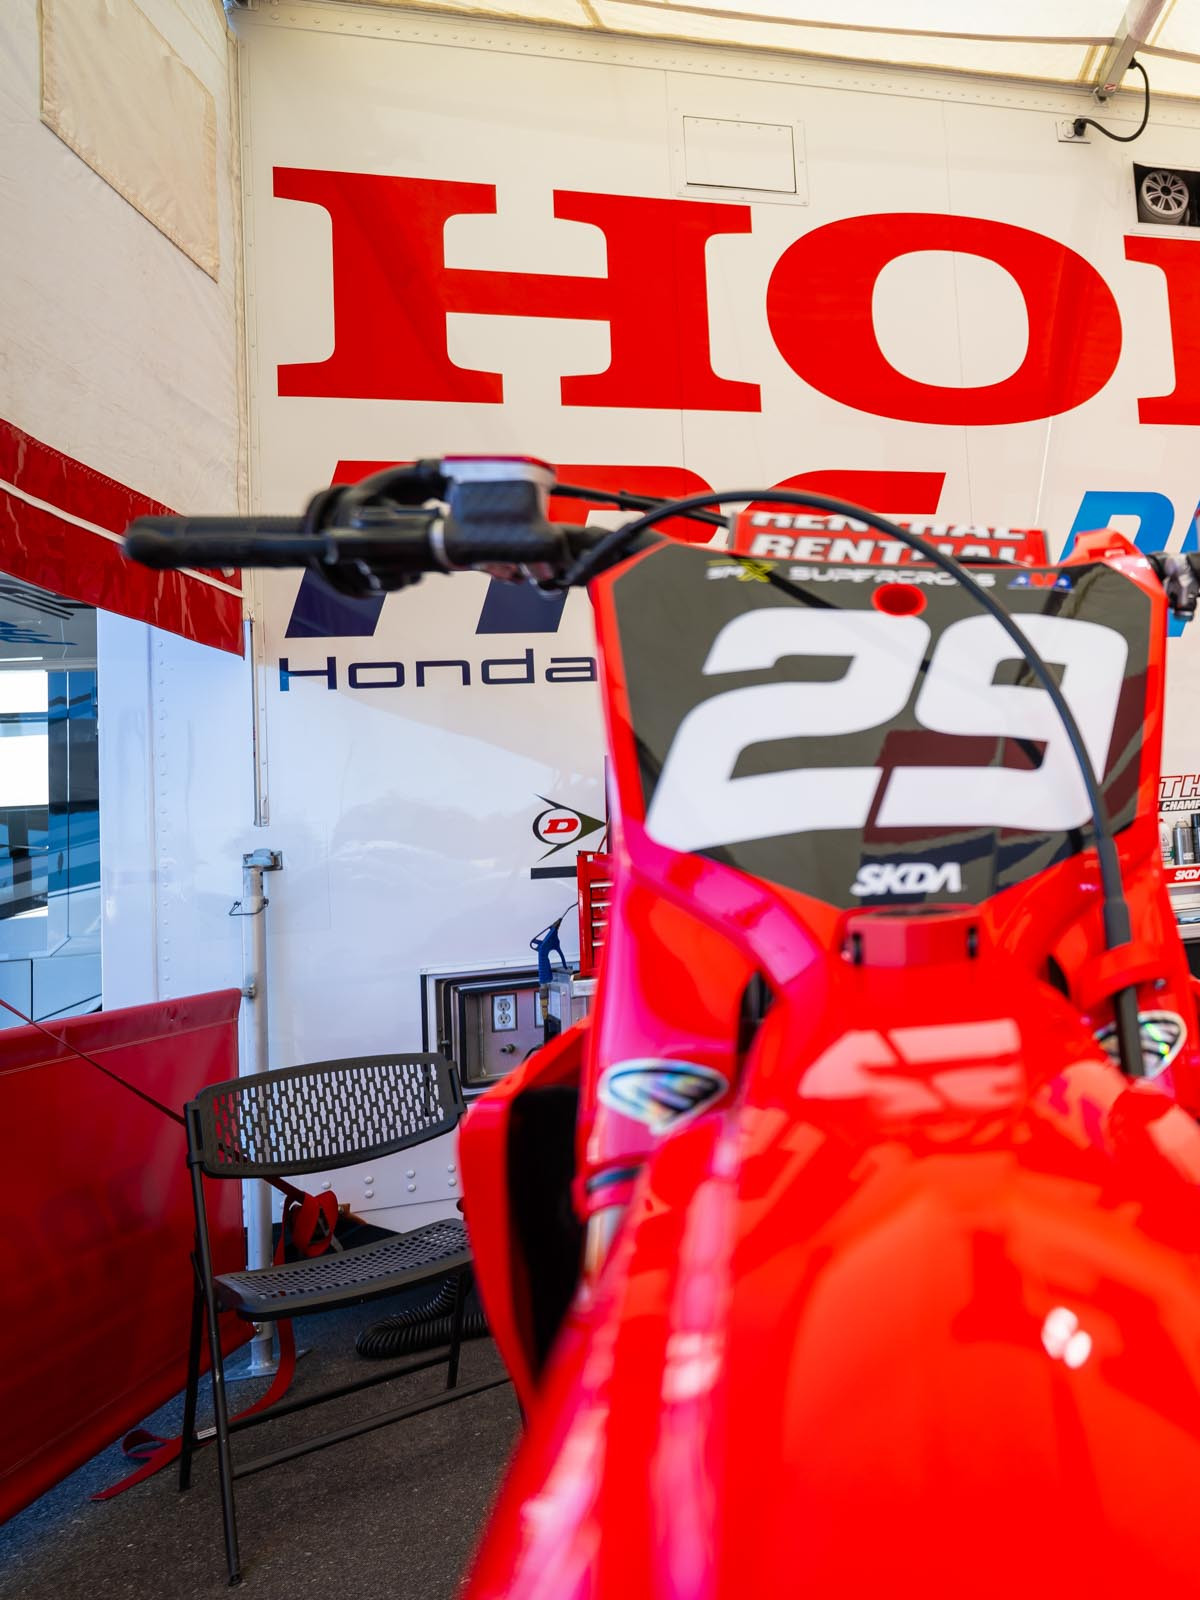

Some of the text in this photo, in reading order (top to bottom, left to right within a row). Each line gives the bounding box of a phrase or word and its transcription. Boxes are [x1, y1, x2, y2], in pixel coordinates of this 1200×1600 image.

[789, 566, 996, 587] SUPERCROS
[279, 647, 596, 692] Honda
[644, 607, 1130, 853] 29
[850, 862, 962, 896] SKDA
